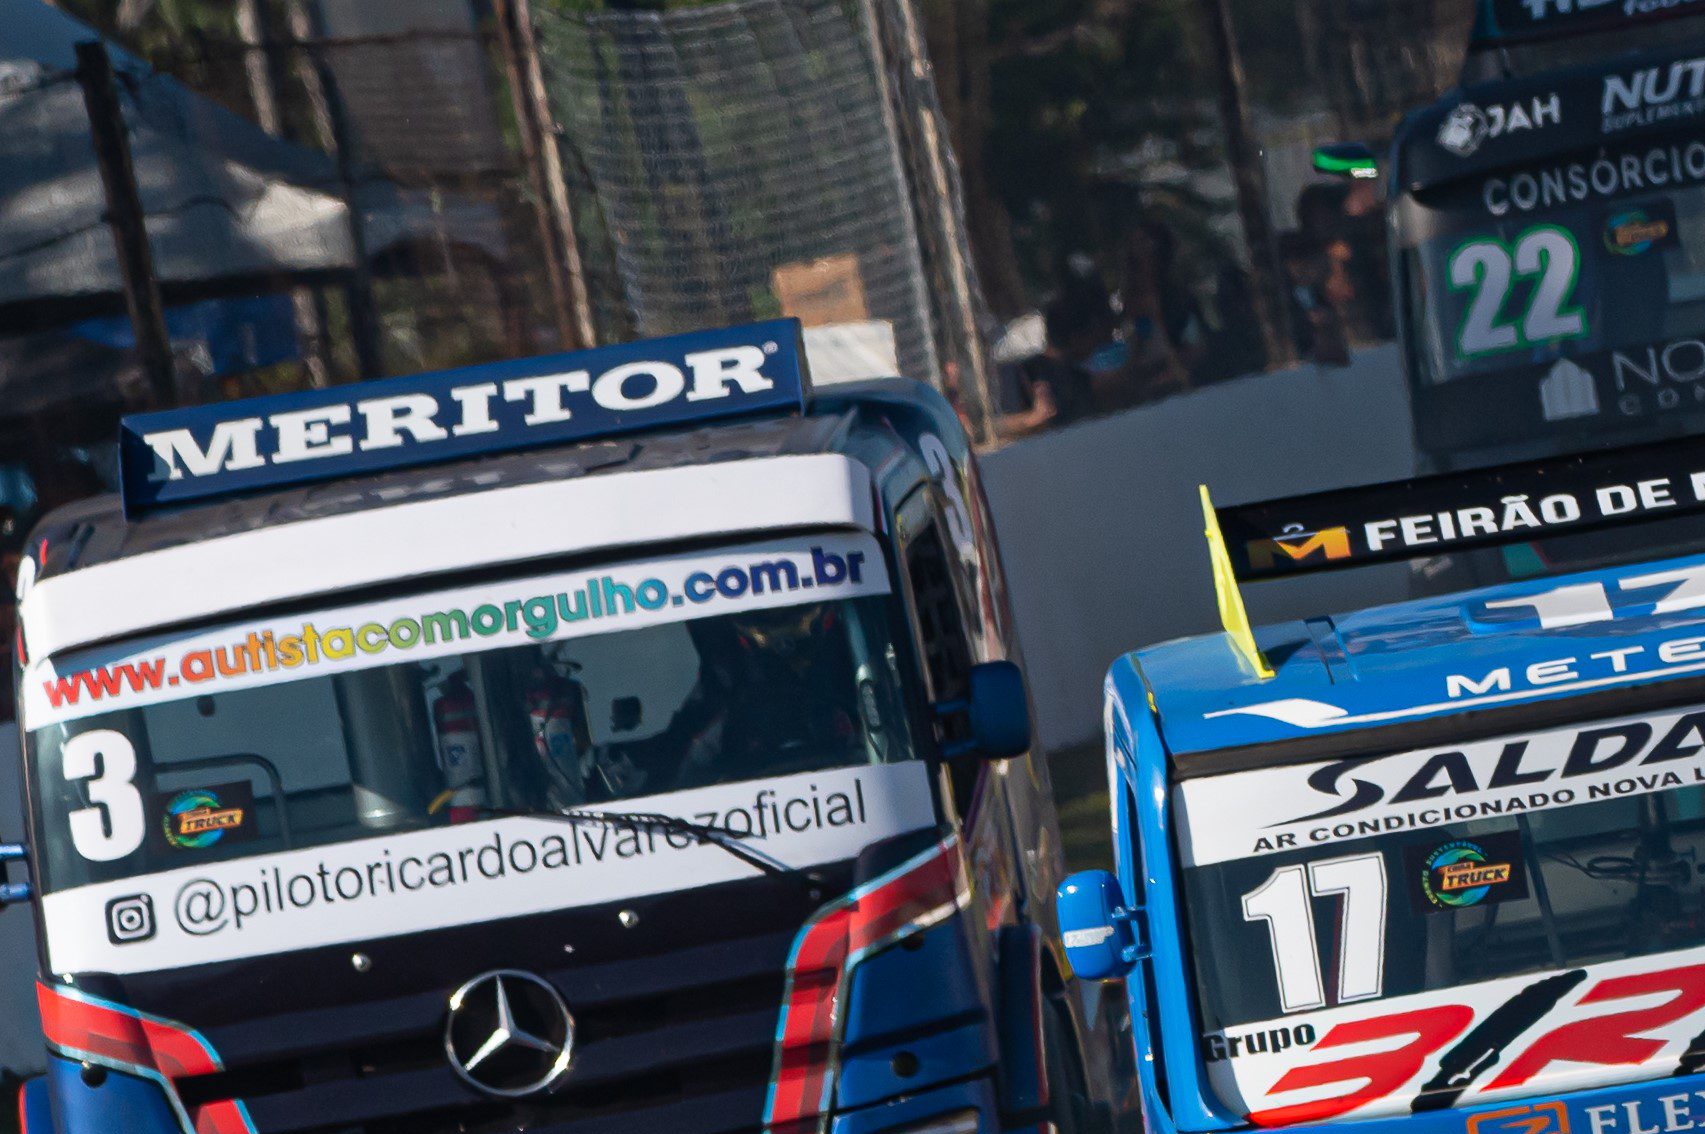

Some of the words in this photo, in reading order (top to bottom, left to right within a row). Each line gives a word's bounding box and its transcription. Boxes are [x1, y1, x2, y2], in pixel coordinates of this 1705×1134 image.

[1447, 222, 1590, 361] 22
[143, 344, 775, 483] MERITOR
[1364, 494, 1582, 553] FEIRÃO
[1597, 478, 1677, 518] DE
[44, 546, 866, 709] www.autistacomorgulho.com.br
[62, 729, 146, 861] 3
[1252, 831, 1297, 853] AR
[1308, 788, 1576, 843] CONDICIONADO
[1587, 769, 1682, 800] NOVA
[1241, 850, 1388, 1015] 17
[1446, 867, 1507, 888] TRUCK
[1201, 1020, 1317, 1063] Grupo
